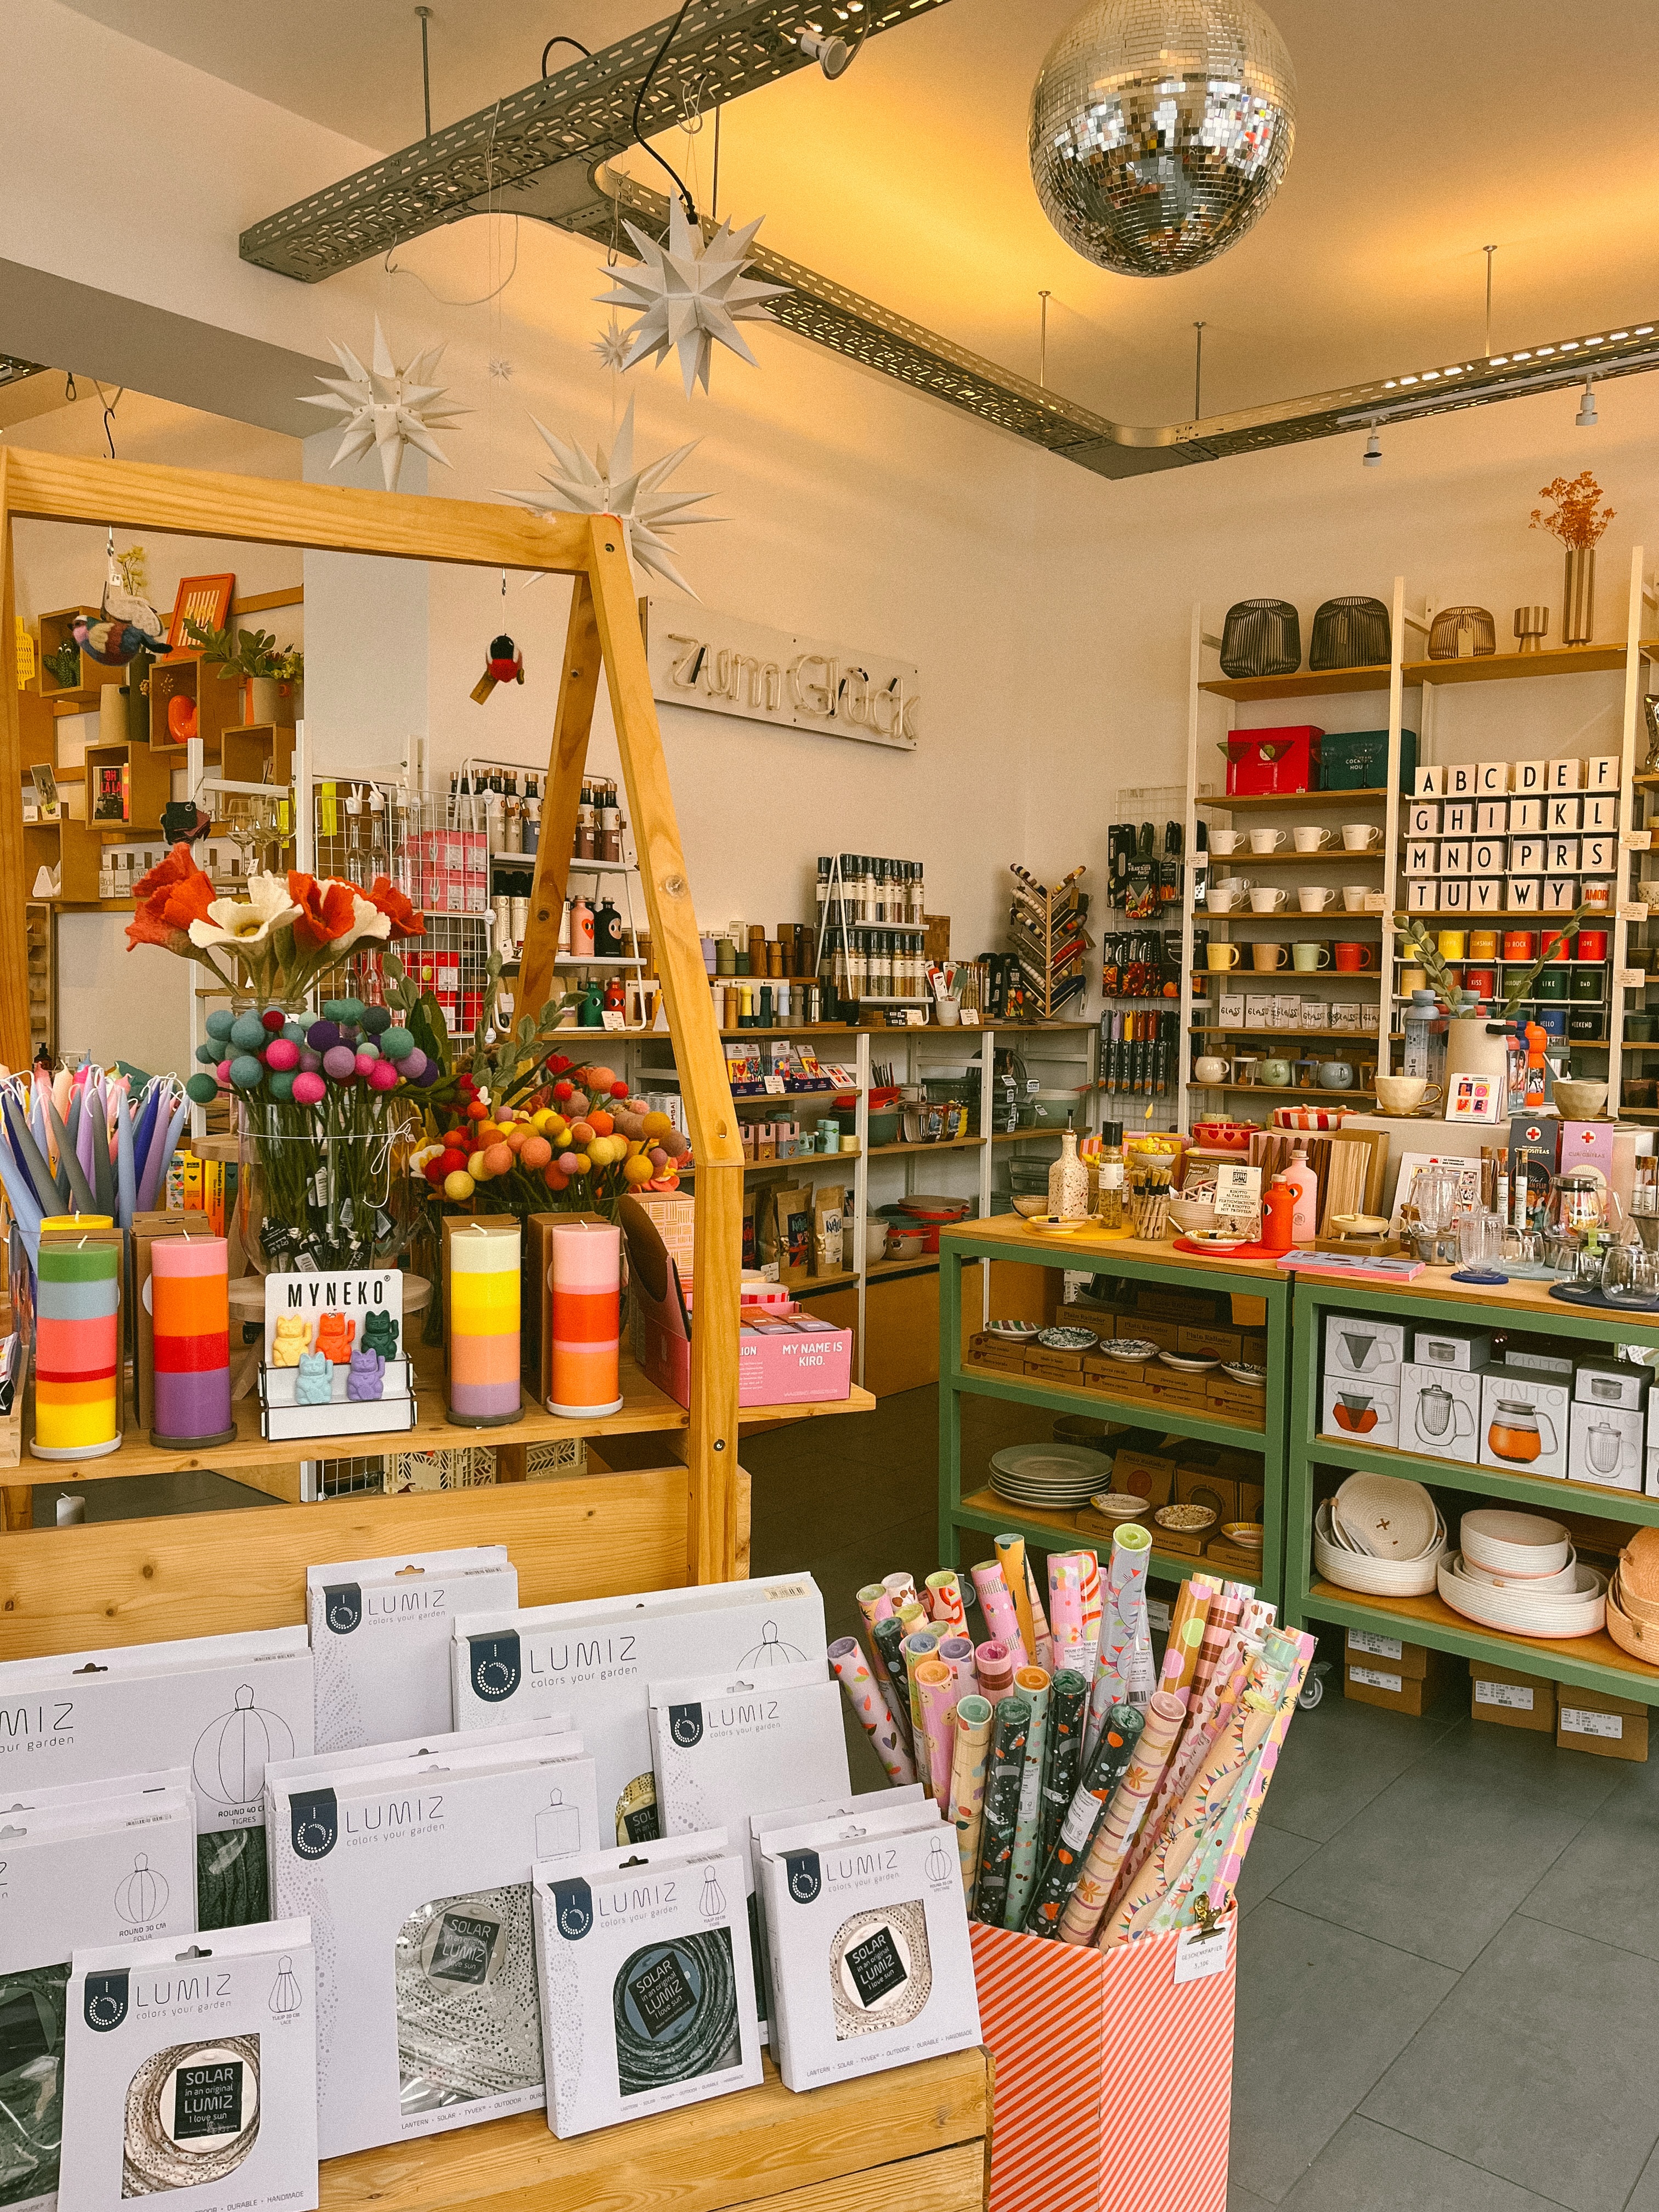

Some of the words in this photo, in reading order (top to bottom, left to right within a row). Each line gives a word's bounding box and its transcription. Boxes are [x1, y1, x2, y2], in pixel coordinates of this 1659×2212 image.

[101, 781, 110, 793] LA
[112, 781, 122, 793] LA
[105, 770, 116, 781] OH
[1423, 771, 1434, 792] A
[1456, 770, 1466, 791] B
[1485, 768, 1497, 789] C
[1524, 766, 1536, 787] D
[1558, 765, 1567, 787] E
[1599, 761, 1608, 783] F
[1417, 810, 1427, 831] G
[1452, 809, 1463, 830] H
[1489, 807, 1493, 828] I
[1522, 805, 1526, 826] J
[1555, 803, 1566, 825] K
[1594, 802, 1602, 824] L
[1414, 848, 1426, 868] M
[1448, 848, 1459, 868] N
[1477, 847, 1491, 867] O
[1521, 845, 1532, 866] P
[1556, 844, 1567, 866] R
[1592, 843, 1602, 865] S
[1418, 885, 1426, 906] T
[1448, 884, 1459, 906] U
[1479, 885, 1489, 906] V
[1514, 884, 1531, 905] W
[1553, 883, 1564, 906] Y
[739, 1346, 757, 1356] ION
[782, 1344, 799, 1355] MY
[801, 1342, 831, 1354] NAME
[833, 1341, 843, 1352] IS
[799, 1355, 826, 1367] KIRO.
[1404, 1365, 1476, 1392] KINTO
[1485, 1378, 1564, 1407] KINTO
[368, 1589, 445, 1616] LUMIZ
[368, 1616, 394, 1626] colors
[397, 1614, 416, 1624] your
[418, 1609, 446, 1621] garden
[530, 1635, 637, 1674] LUMIZ
[531, 1675, 566, 1689] colors
[571, 1672, 595, 1684] your
[601, 1666, 638, 1680] garden
[708, 1701, 779, 1728] LUMIZ
[710, 1730, 733, 1739] colors
[736, 1726, 752, 1736] your
[755, 1722, 780, 1733] garden
[27, 1735, 75, 1752] garden
[218, 1808, 245, 1818] ROUND
[232, 1816, 256, 1825] TIGRES
[346, 1796, 444, 1832] LUMIZ
[346, 1834, 379, 1847] colors
[383, 1830, 405, 1841] your
[410, 1823, 445, 1837] garden
[827, 1850, 898, 1882] LUMIZ
[828, 1882, 851, 1892] colors
[855, 1877, 871, 1888] your
[874, 1872, 900, 1883] garden
[600, 1882, 676, 1916] LUMIZ
[601, 1916, 625, 1928] colors
[630, 1912, 647, 1922] your
[651, 1905, 678, 1918] garden
[119, 1927, 144, 1937] ROUND
[449, 1918, 491, 1939] SOLAR
[442, 1943, 485, 1963] LUMIZ
[464, 1936, 487, 1948] original
[852, 1934, 887, 1964] SOLAR
[1181, 1945, 1223, 1961] GESCHENKPAPIER
[448, 1958, 462, 1968] love
[464, 1961, 476, 1970] sun
[856, 1965, 862, 1973] in
[863, 1960, 871, 1969] an
[870, 1946, 890, 1965] original
[860, 1954, 895, 1985] LUMIZ
[636, 1960, 673, 1994] SOLAR
[647, 1988, 656, 1997] an
[656, 1970, 677, 1993] original
[872, 1974, 884, 1989] love
[884, 1969, 895, 1980] sun
[137, 1973, 231, 2007] LUMIZ
[645, 1979, 682, 2016] LUMIZ
[136, 2008, 167, 2021] colors
[171, 2005, 193, 2017] your
[197, 1999, 232, 2012] garden
[658, 2003, 672, 2017] love
[671, 1994, 682, 2007] sun
[807, 2067, 831, 2078] LANTERN
[837, 2060, 854, 2069] SOLAR
[886, 2045, 910, 2057] OUTDOOR
[917, 2038, 939, 2049] DURABLE
[945, 2029, 973, 2041] HANDMADE
[185, 2067, 234, 2086] SOLAR
[205, 2083, 233, 2094] original
[184, 2095, 233, 2114] LUMIZ
[401, 2118, 429, 2130] LANTERN
[437, 2112, 456, 2123] SOLAR
[494, 2096, 522, 2109] OUTDOOR
[193, 2113, 211, 2123] love
[213, 2111, 227, 2120] sun
[227, 2198, 258, 2211] DURABLE
[267, 2191, 304, 2203] HANDMADE
